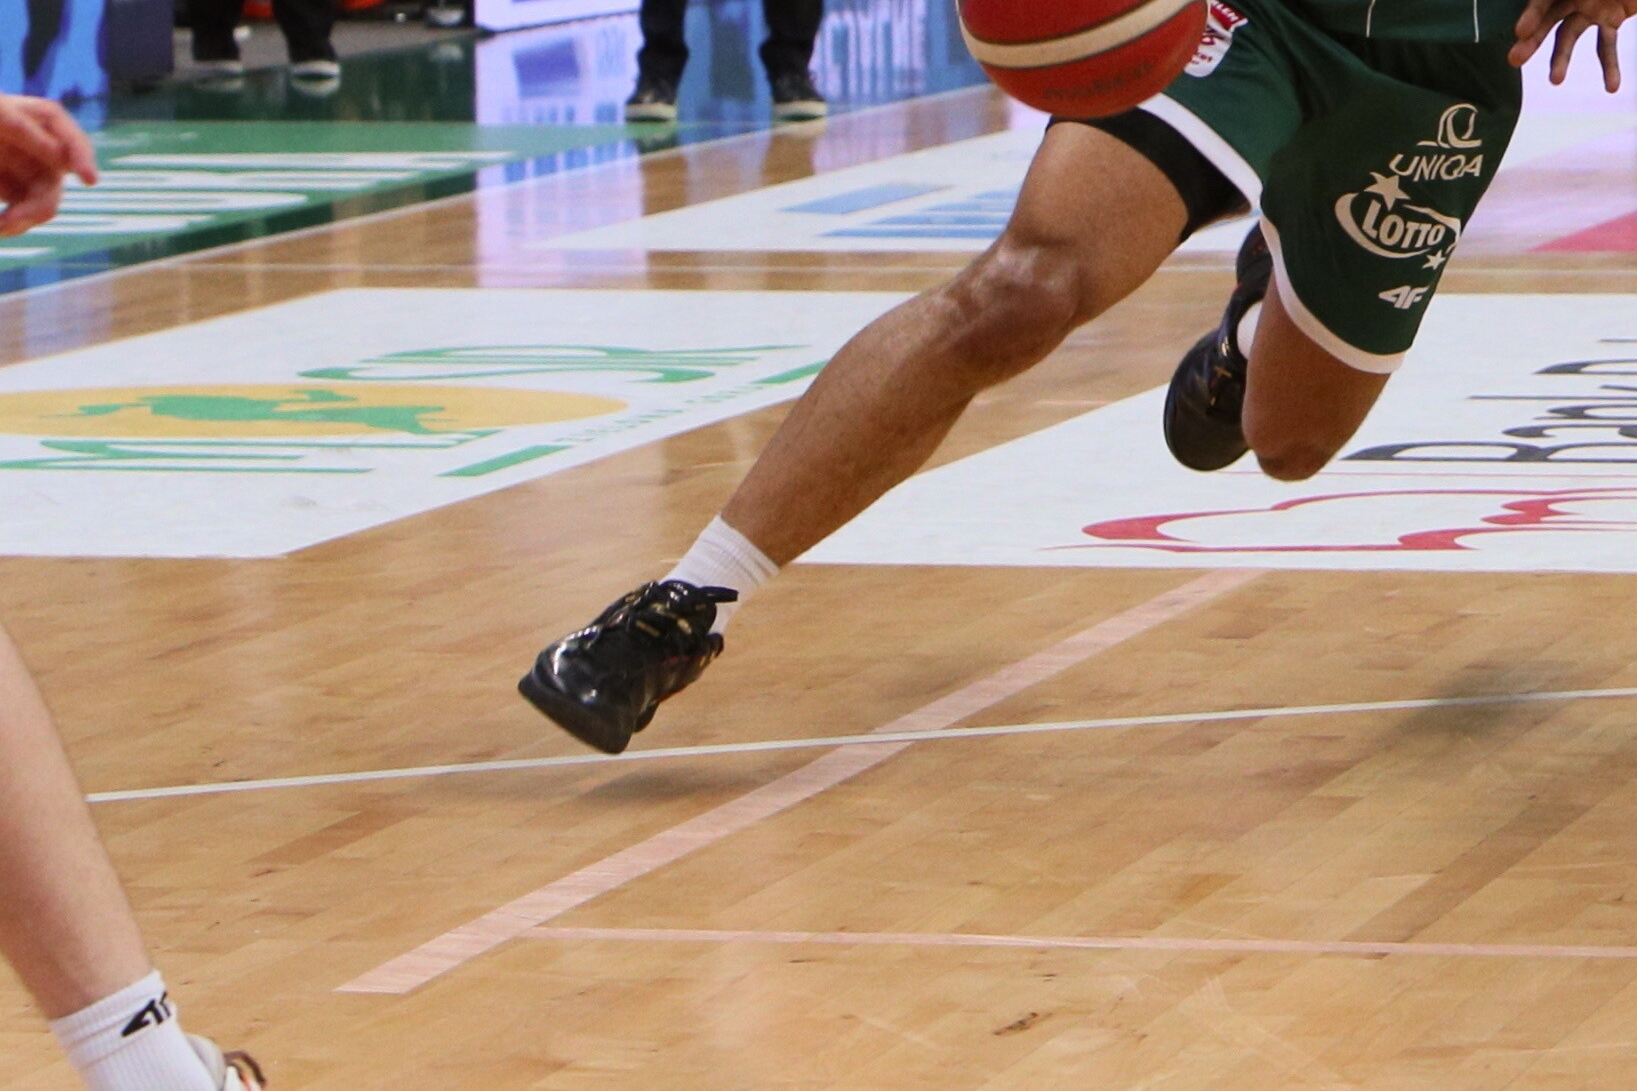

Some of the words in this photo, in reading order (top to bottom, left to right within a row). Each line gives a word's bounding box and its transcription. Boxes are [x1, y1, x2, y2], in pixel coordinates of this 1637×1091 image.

[1389, 154, 1483, 182] UNIQA
[1361, 199, 1447, 249] LOTTO
[1378, 285, 1431, 310] 4F
